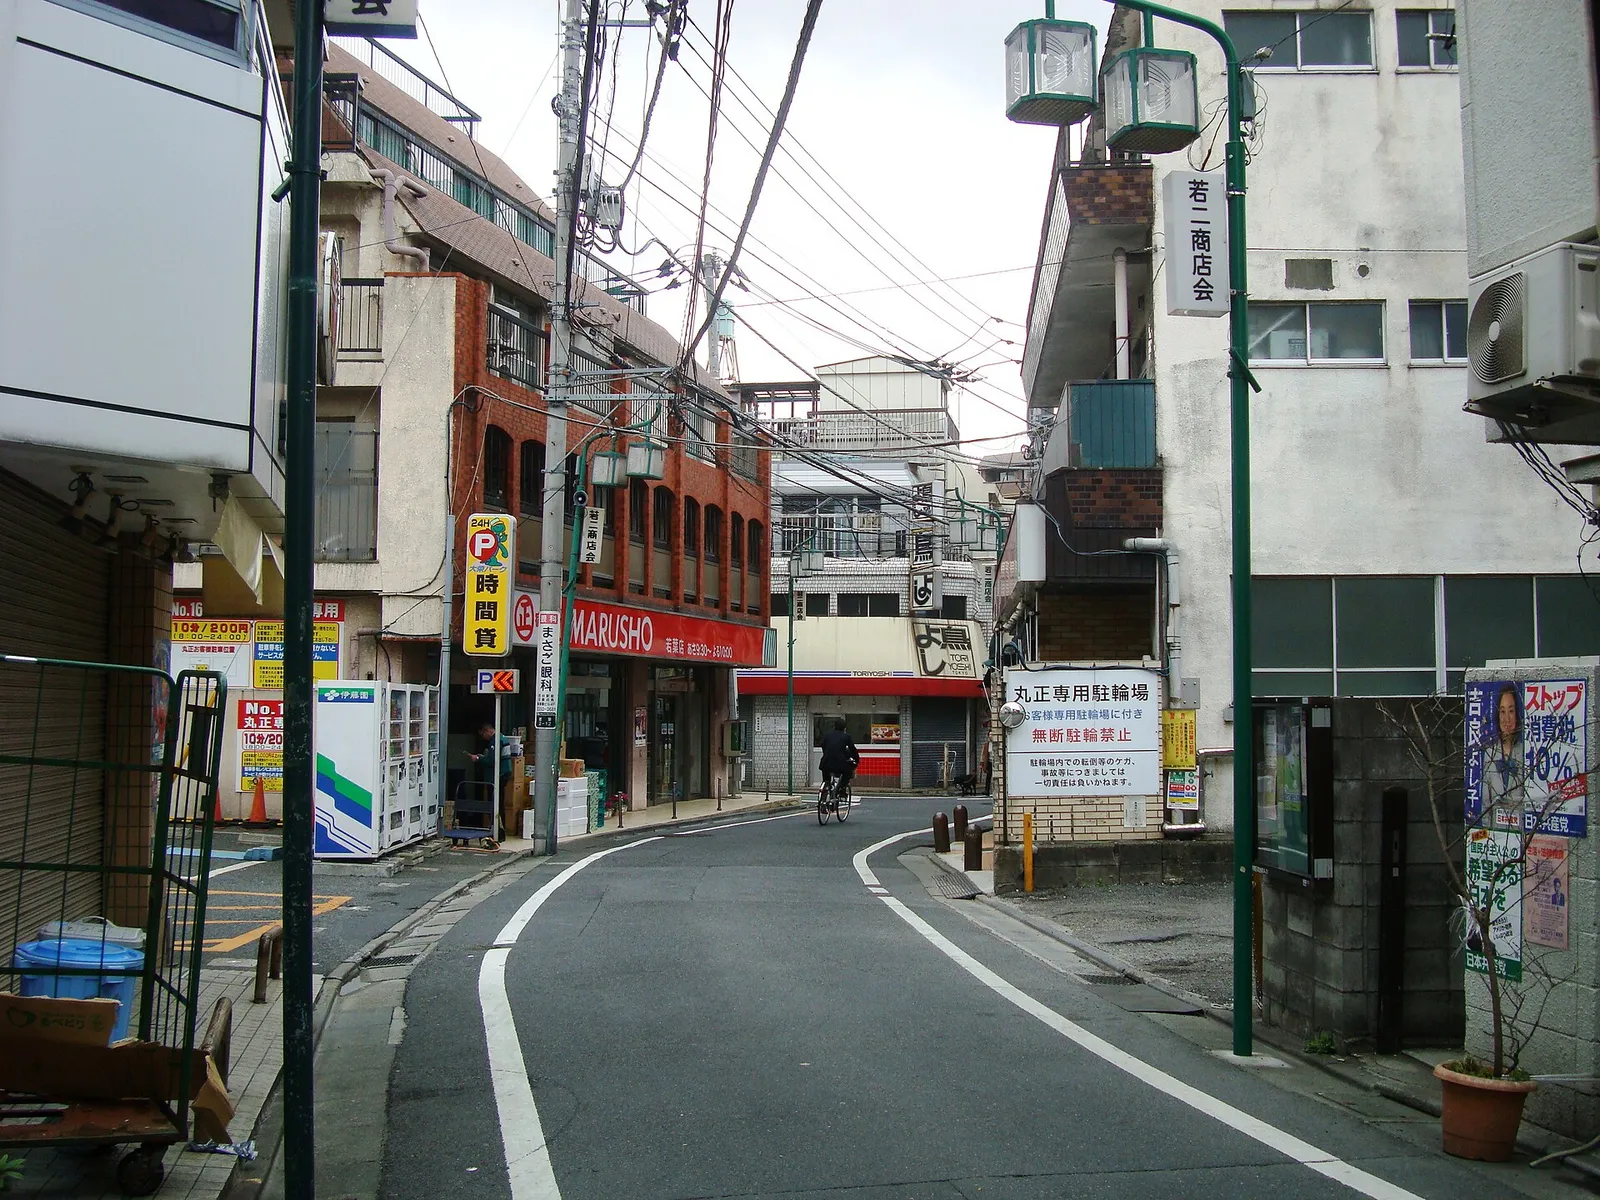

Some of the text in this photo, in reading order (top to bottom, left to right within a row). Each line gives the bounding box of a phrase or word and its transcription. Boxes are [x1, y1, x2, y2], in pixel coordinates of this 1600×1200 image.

[1188, 179, 1214, 302] 若二商店会
[471, 519, 490, 527] 24H
[475, 533, 496, 557] P
[585, 510, 599, 562] 若二商店会
[172, 603, 203, 617] No.16
[474, 574, 499, 649] 時間貸
[173, 622, 248, 633] 10分/200円
[569, 608, 653, 652] MARUSHO
[540, 627, 554, 692] まさご眼科
[948, 663, 971, 671] YOSHI
[950, 654, 969, 662] TORI
[479, 672, 493, 690] P
[340, 691, 369, 700] 伊藤園
[1014, 683, 1149, 702] 丸正専用駐輪場
[1525, 683, 1583, 711] ストップ
[1032, 728, 1132, 743] 無断駐輪禁止
[1525, 715, 1576, 743] 消費税
[1467, 687, 1483, 808] 吉良よし子
[1041, 768, 1125, 777] 事故等につきましては
[1525, 746, 1572, 781] 10%
[1035, 779, 1131, 787] 一切責任は負いかねます。
